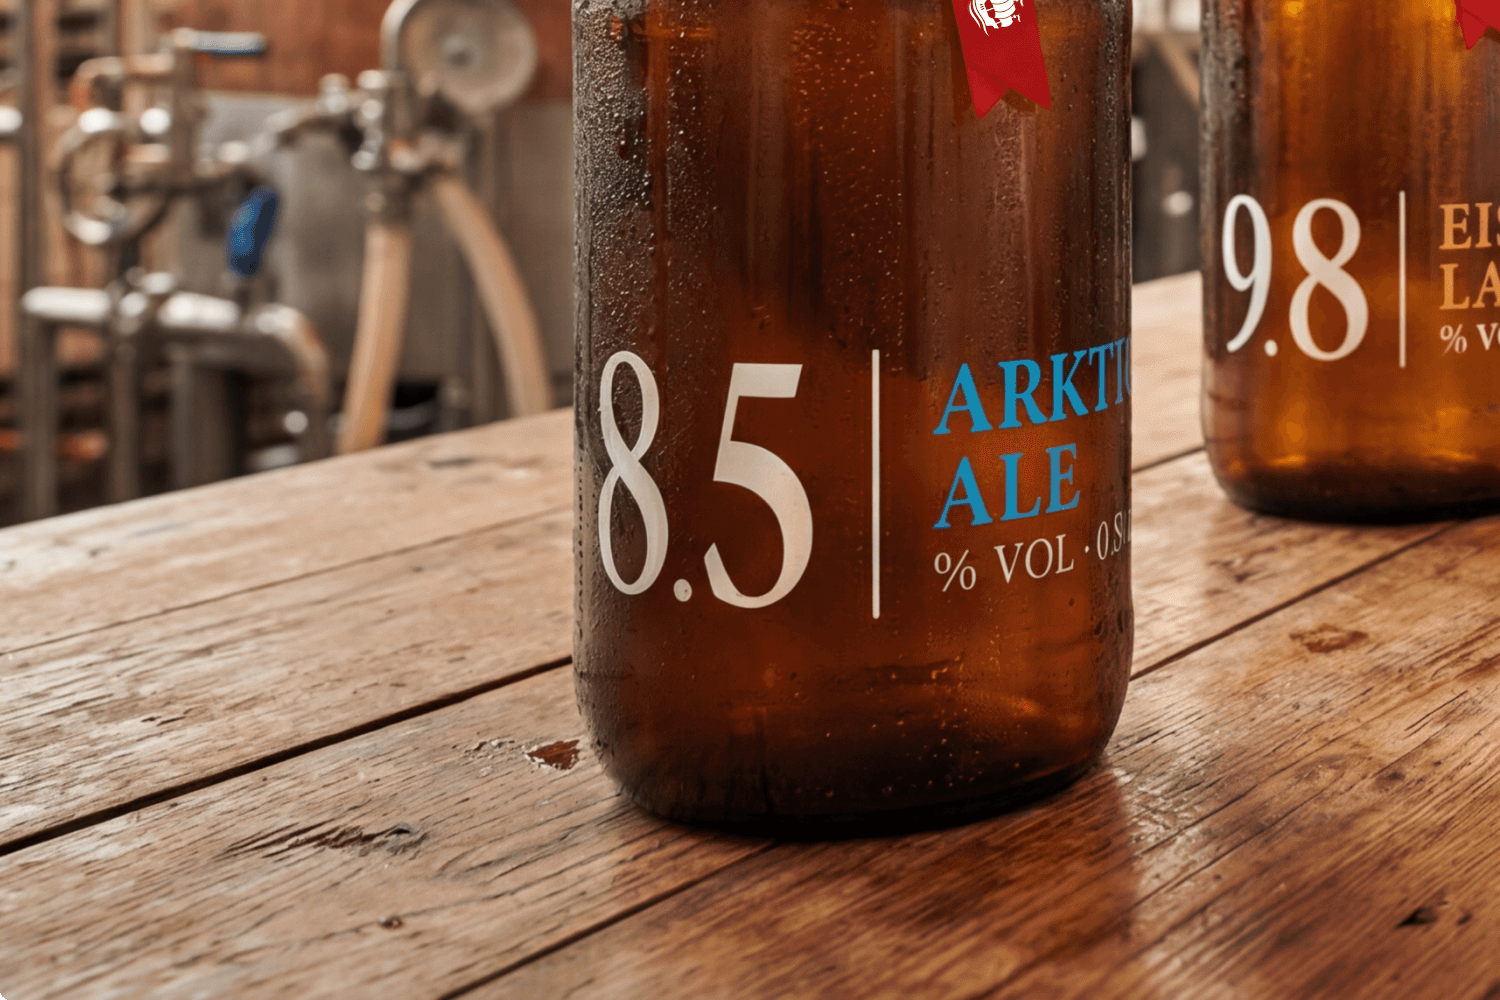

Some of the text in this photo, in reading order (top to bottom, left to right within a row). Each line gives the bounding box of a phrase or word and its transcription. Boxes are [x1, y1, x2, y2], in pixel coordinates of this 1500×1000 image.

[1222, 194, 1369, 361] 9.8
[1439, 323, 1468, 354] %
[598, 350, 813, 609] 8.5
[933, 443, 1081, 529] ALE
[934, 549, 977, 593] %
[993, 533, 1075, 584] VOL
